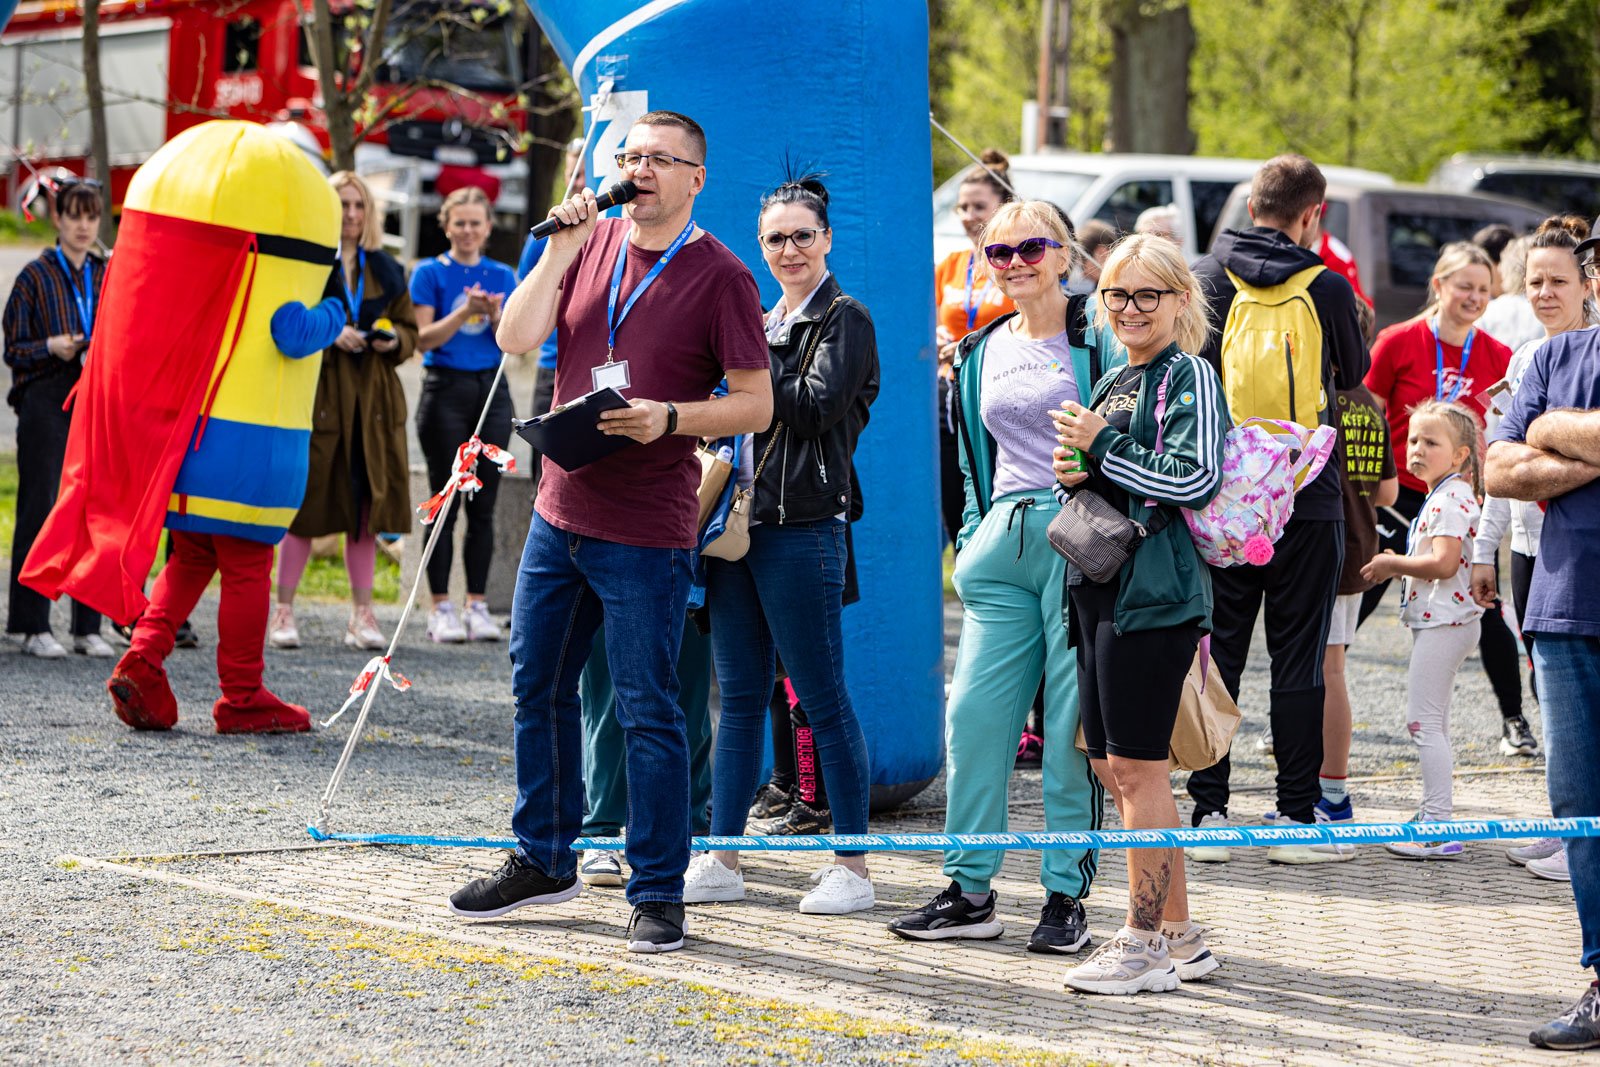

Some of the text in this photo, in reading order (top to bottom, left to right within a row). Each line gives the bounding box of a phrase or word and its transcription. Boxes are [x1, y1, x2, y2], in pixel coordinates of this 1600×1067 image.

[1342, 413, 1371, 427] KEEP
[1347, 460, 1383, 473] NURE
[796, 727, 814, 773] COLLEGE
